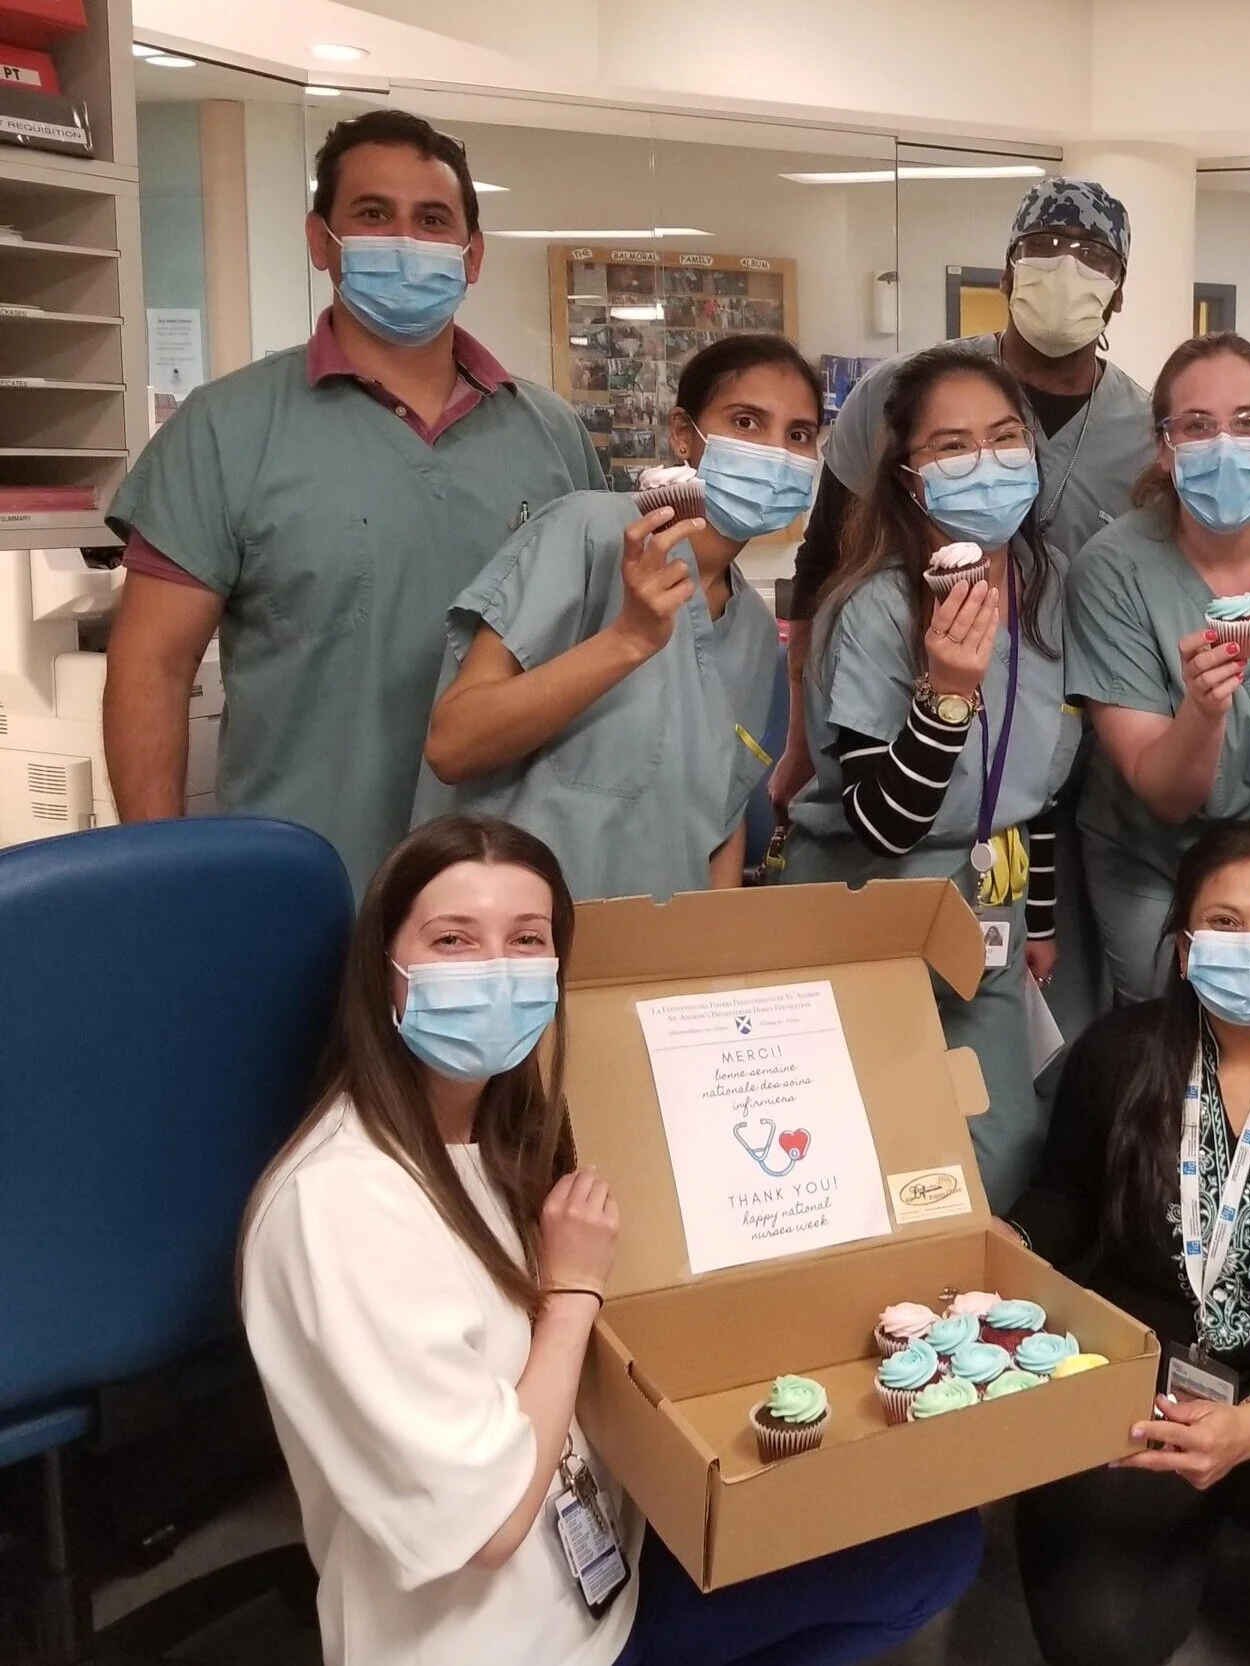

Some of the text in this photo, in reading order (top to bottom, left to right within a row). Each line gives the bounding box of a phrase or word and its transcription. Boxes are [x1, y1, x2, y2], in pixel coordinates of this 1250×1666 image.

[3, 66, 21, 80] PT
[7, 120, 82, 139] REQUISITION
[573, 249, 770, 270] THE BALMORAL FAMILY ALBUM
[721, 1044, 783, 1064] MERCI!
[714, 1063, 799, 1081] bonne semaine
[702, 1077, 813, 1099] nationale des soins
[732, 1094, 797, 1118] infirmiers
[728, 1175, 839, 1209] THANK YOU!
[742, 1196, 832, 1228] happy national
[751, 1213, 830, 1241] nurses week
